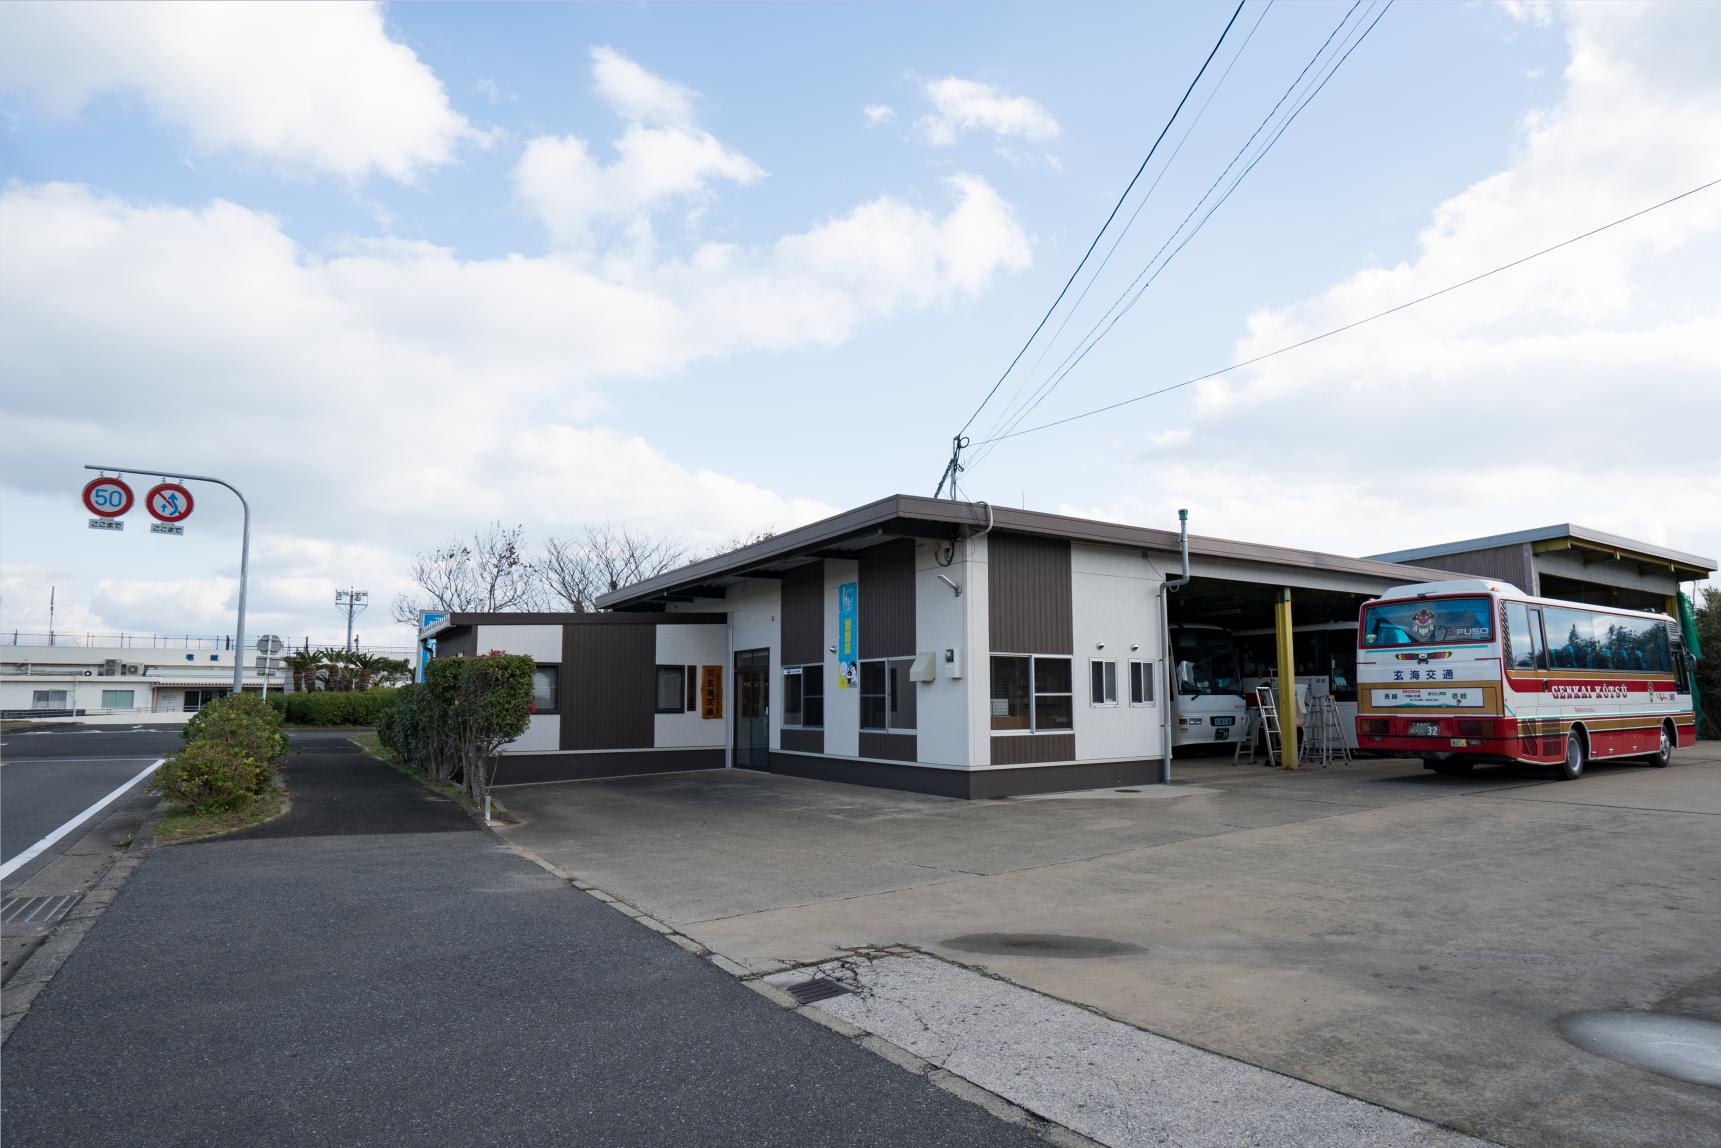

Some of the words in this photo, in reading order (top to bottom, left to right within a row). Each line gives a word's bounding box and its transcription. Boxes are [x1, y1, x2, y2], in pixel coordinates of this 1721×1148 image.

[95, 489, 122, 507] 50
[91, 520, 122, 529] ここまで
[152, 525, 182, 534] ここまで
[1456, 627, 1489, 636] FUSO
[1393, 669, 1454, 681] 玄海交通
[1551, 685, 1592, 699] GENKAI
[1427, 726, 1438, 736] 32
